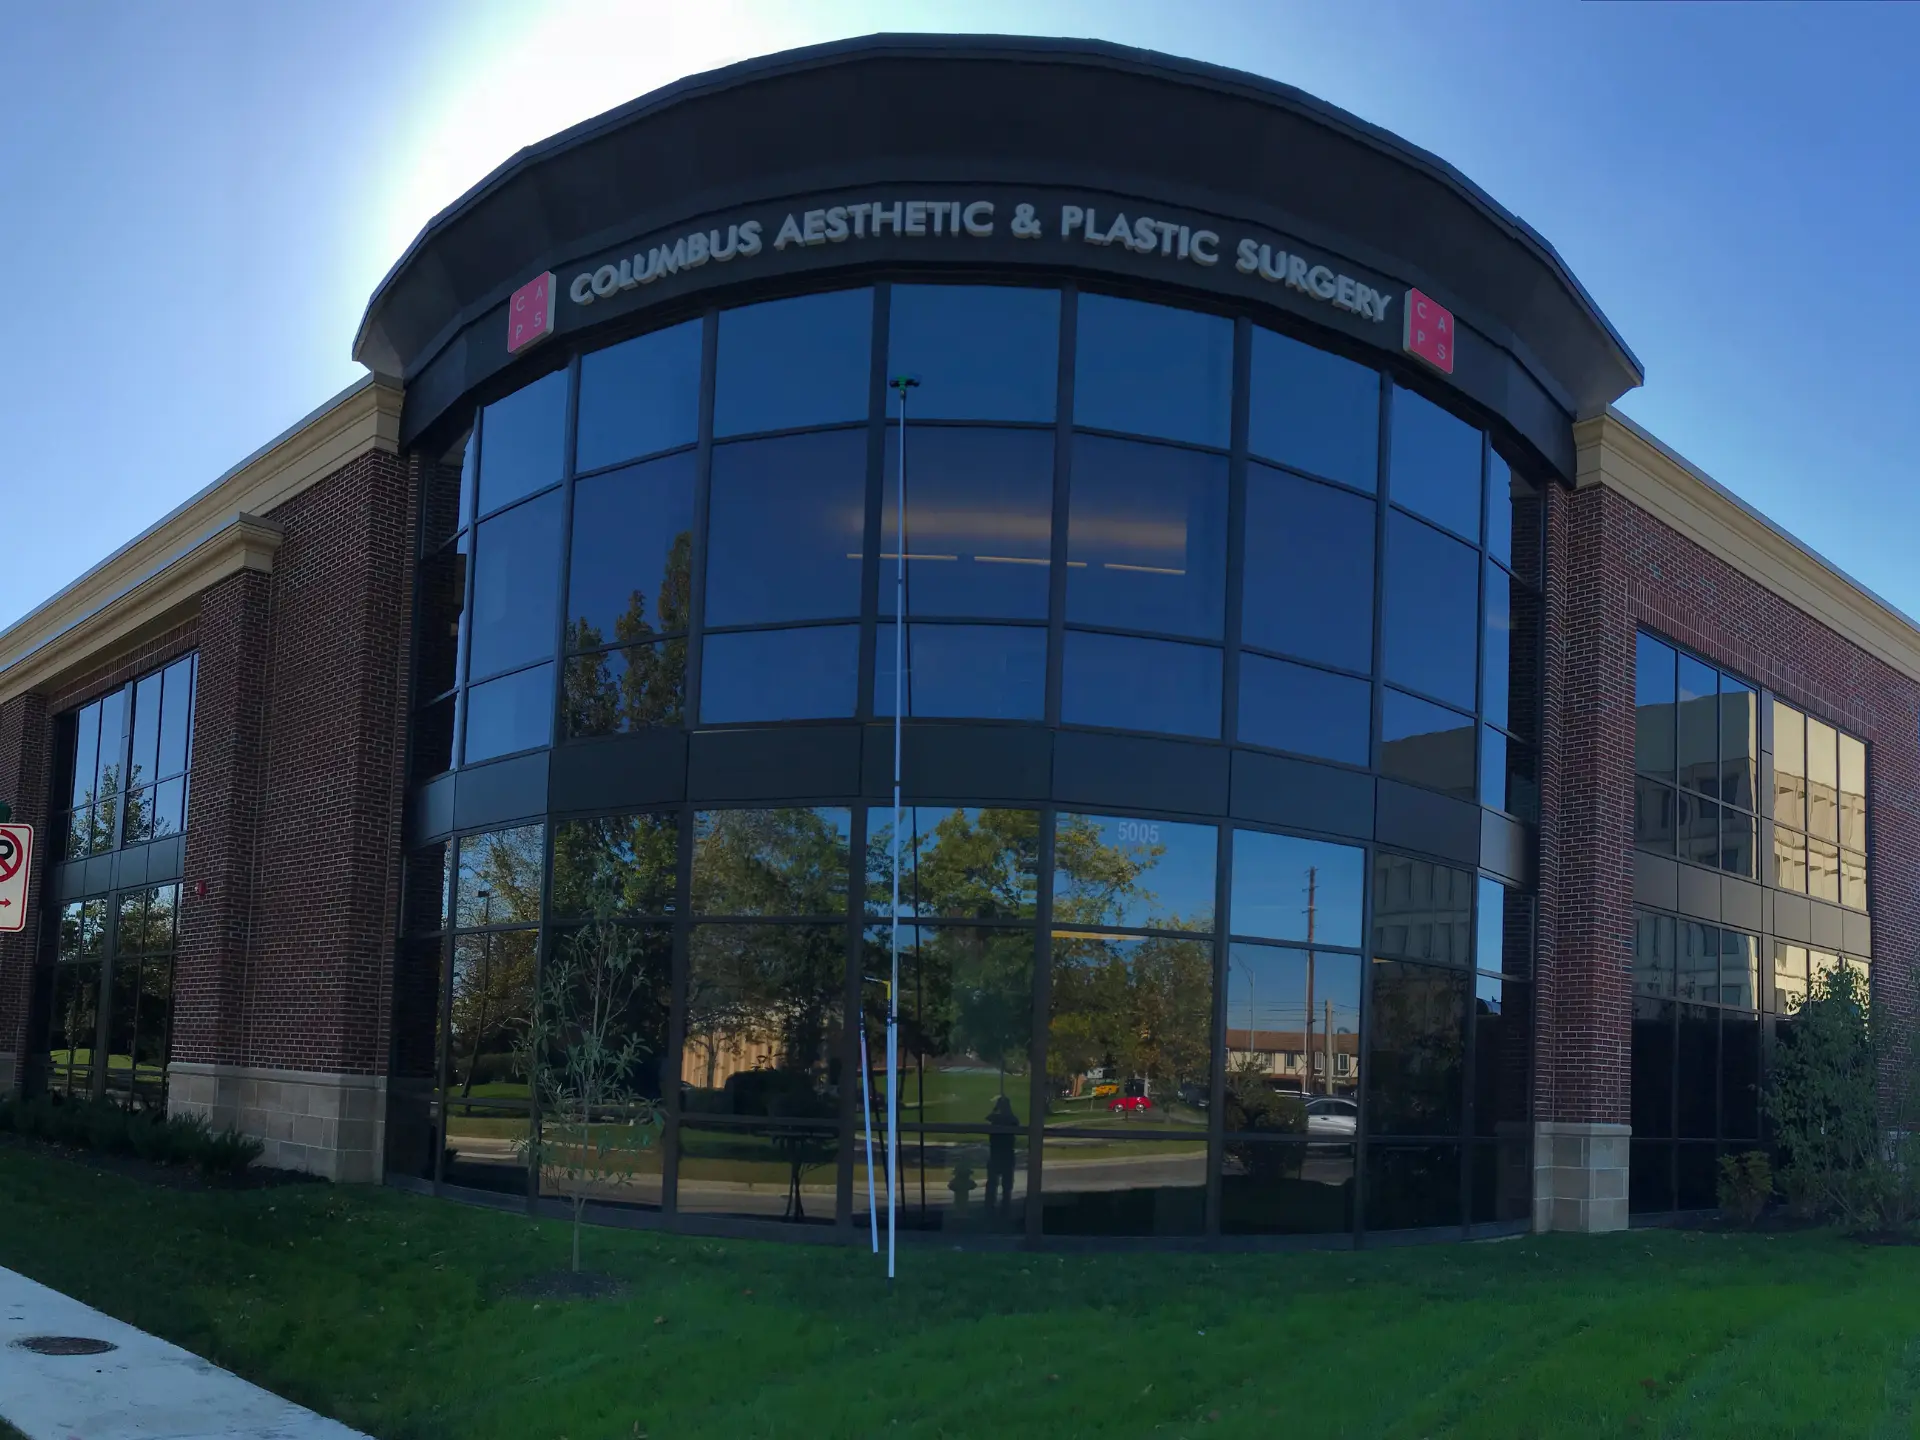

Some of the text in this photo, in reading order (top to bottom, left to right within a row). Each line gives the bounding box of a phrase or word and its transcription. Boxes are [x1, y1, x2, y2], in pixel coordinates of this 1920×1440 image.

[569, 200, 1393, 322] COLUMBUS AESTHETIC & PLASTIC SURGERY
[1118, 821, 1159, 844] 5005
